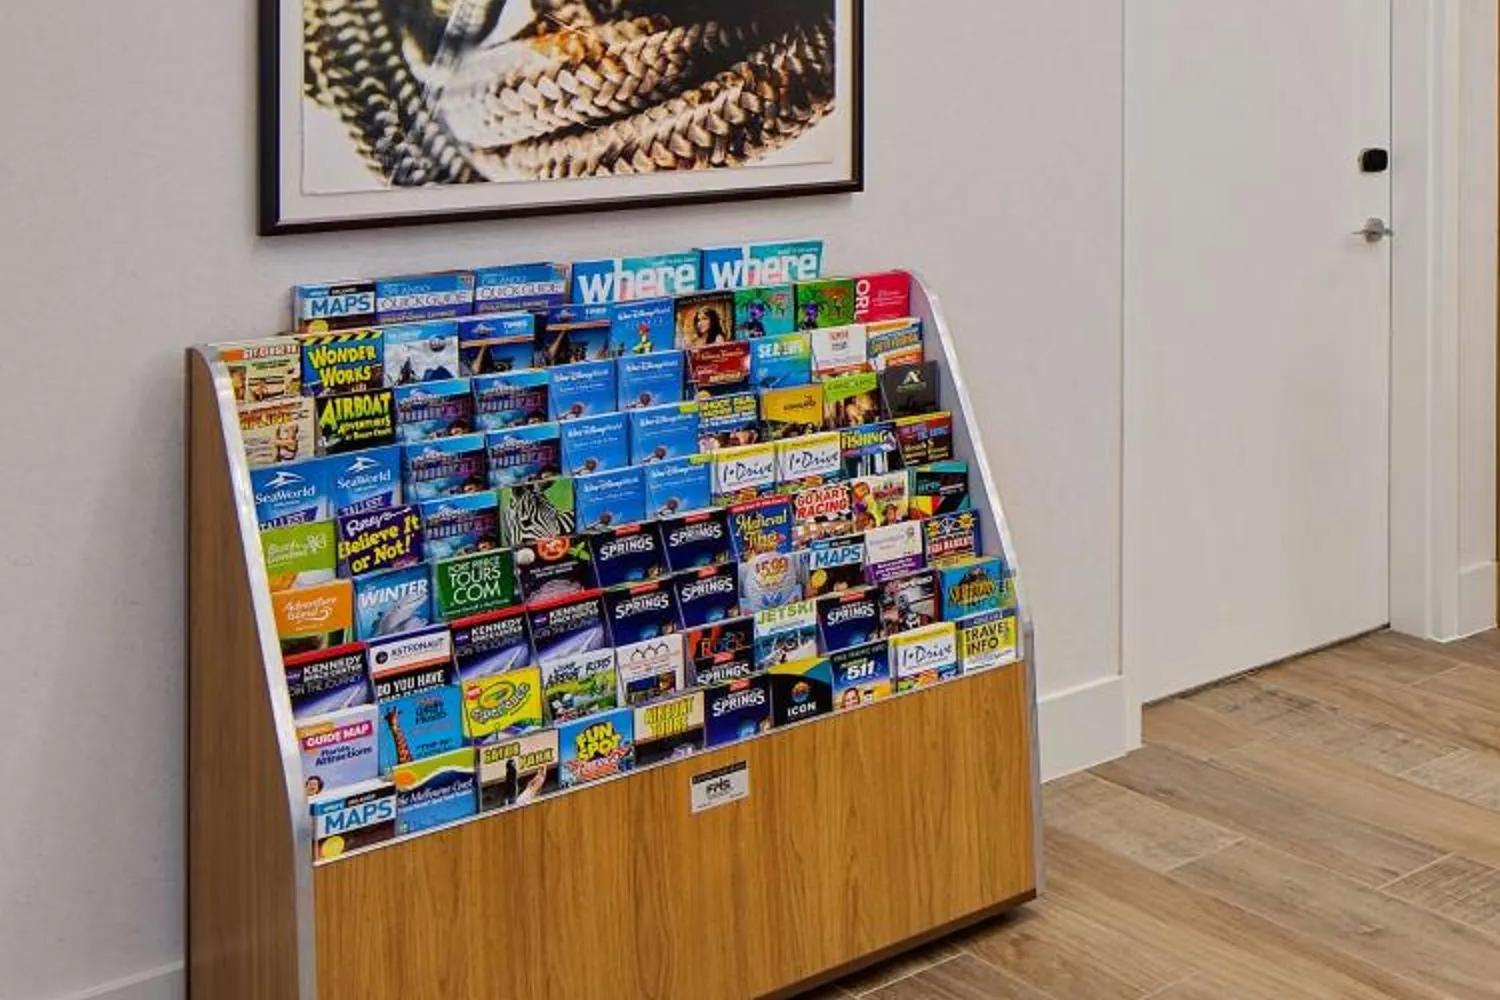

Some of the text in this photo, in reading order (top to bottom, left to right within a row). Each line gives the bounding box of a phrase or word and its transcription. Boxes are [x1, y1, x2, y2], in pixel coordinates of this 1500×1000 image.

[577, 257, 697, 304] where
[710, 246, 818, 290] where
[310, 295, 371, 317] MAPS
[308, 345, 376, 368] WONDER
[319, 365, 371, 387] WORKS
[321, 391, 393, 430] AIRBOAT
[337, 470, 391, 489] SeaWorld
[255, 485, 316, 505] SeaWorld
[795, 499, 849, 519] RACING
[338, 513, 421, 560] Believe It
[600, 535, 654, 561] SPRINGS
[669, 523, 723, 548] SPRINGS
[351, 535, 412, 573] or Not!
[815, 546, 861, 567] MAPS
[449, 567, 501, 589] TOURS
[681, 577, 734, 604] SPRINGS
[358, 579, 429, 608] WINTER
[615, 593, 670, 620] SPRINGS
[757, 600, 814, 625] JETSKI
[826, 602, 875, 627] SPRINGS
[967, 637, 999, 655] INFO
[303, 655, 362, 675] KENNEDY
[392, 677, 415, 691] YOU
[417, 670, 445, 685] HAVE
[711, 689, 765, 717] SPRINGS
[787, 702, 817, 718] ICON
[306, 724, 370, 748] GUIDE MAP
[576, 721, 614, 746] FUN
[324, 800, 393, 834] MAPS
